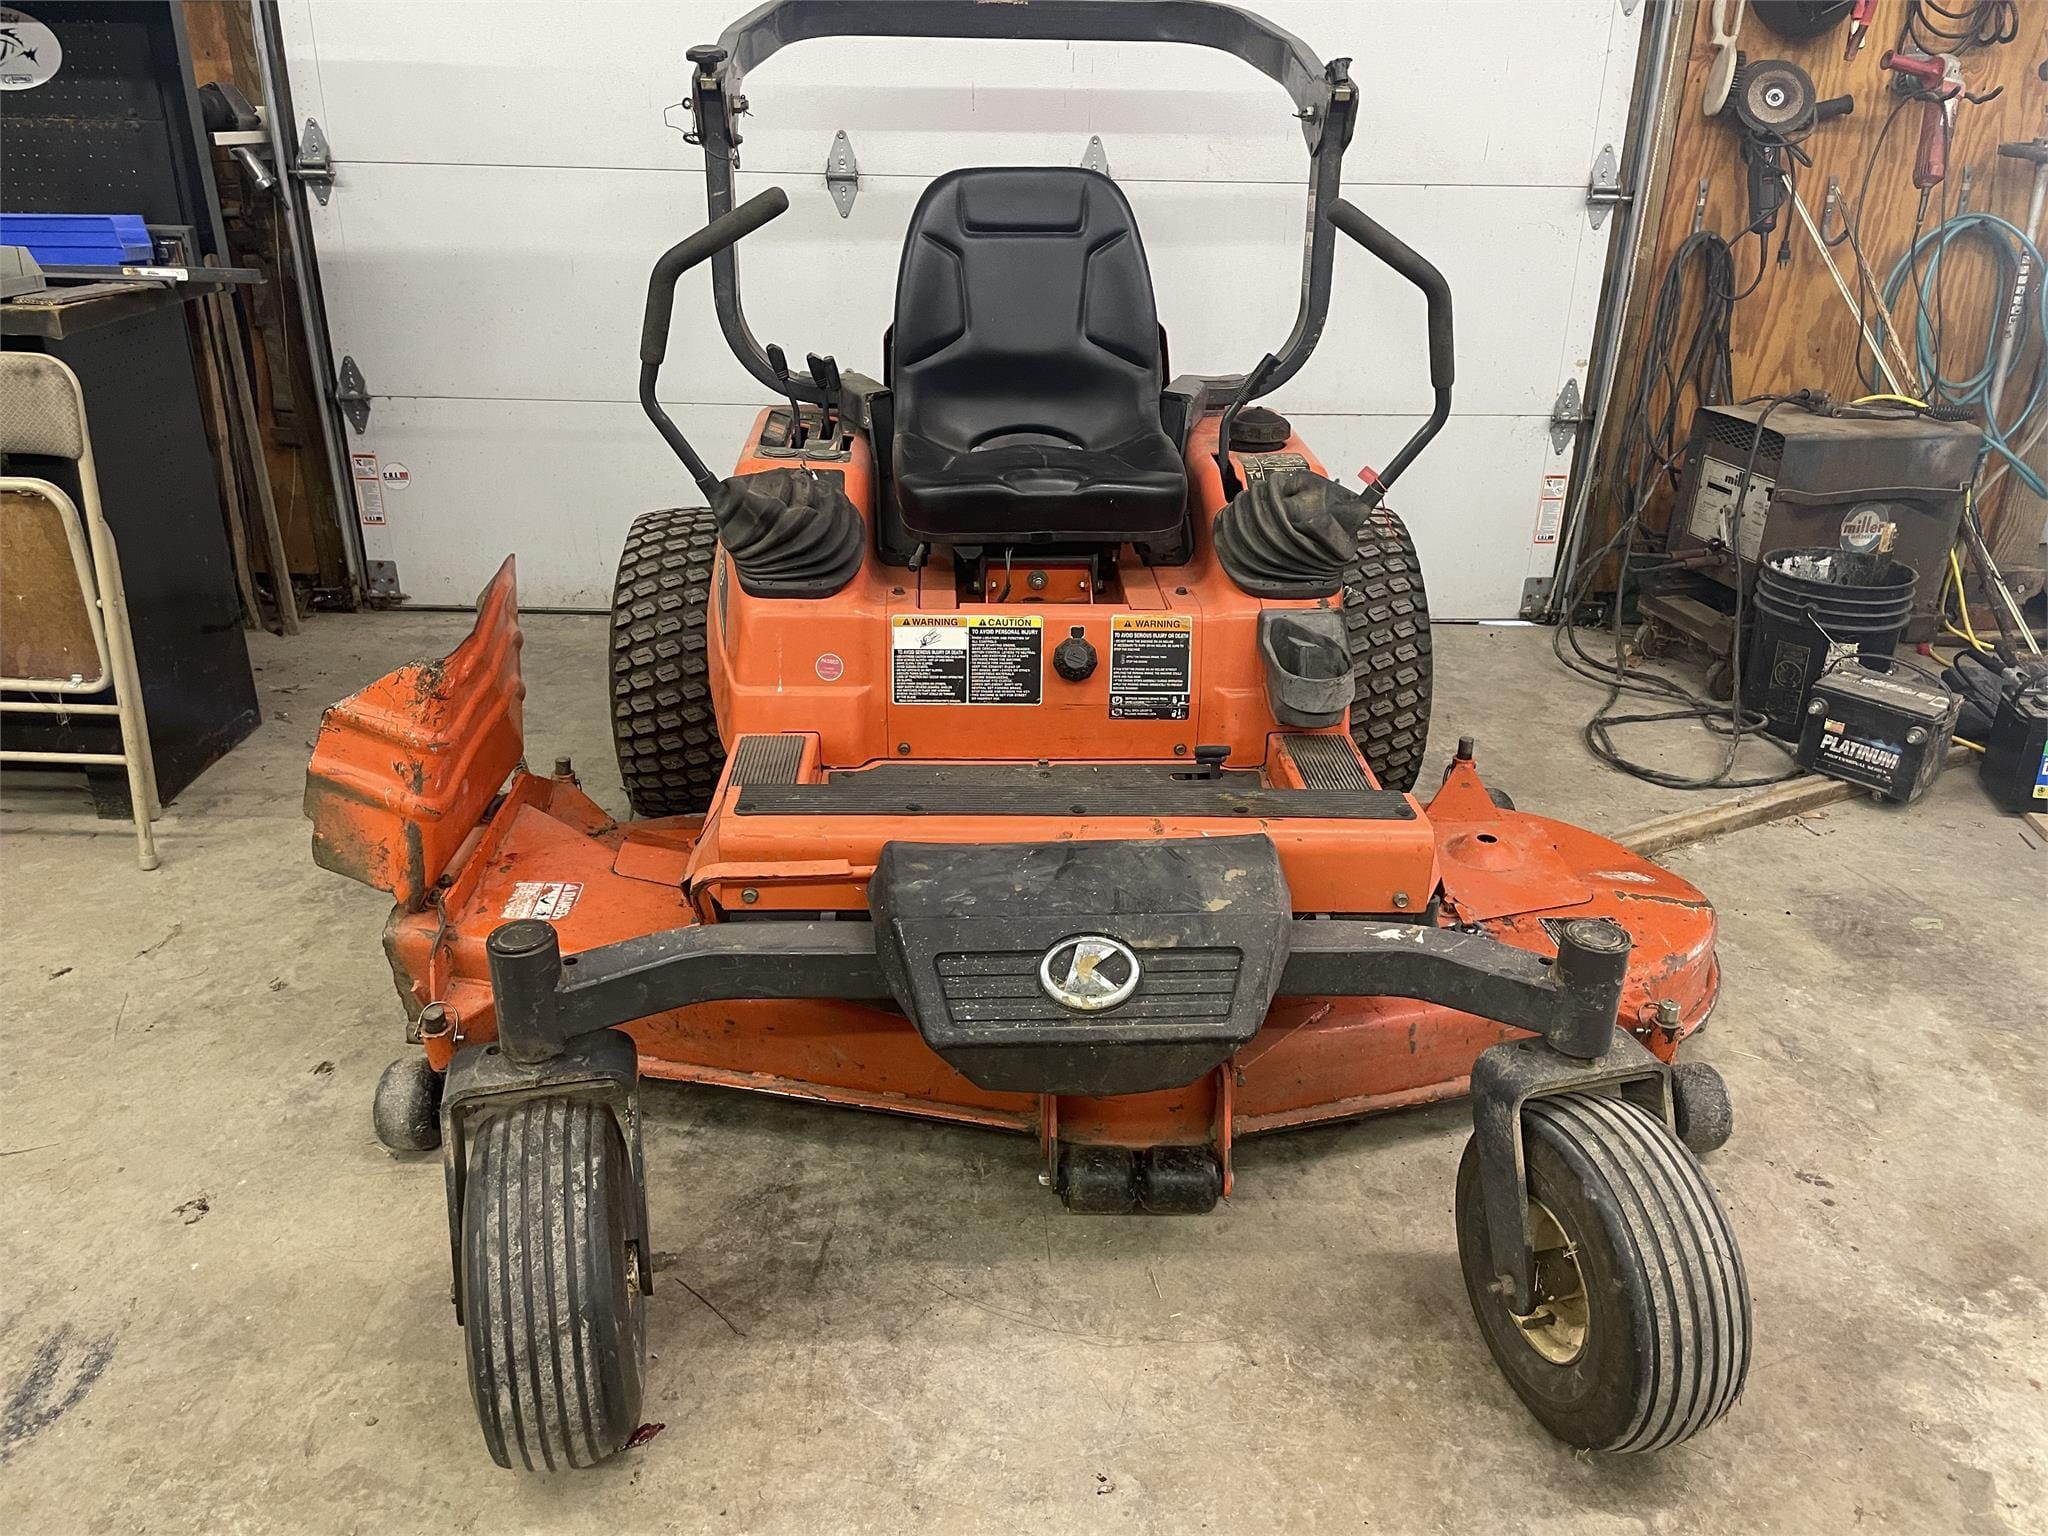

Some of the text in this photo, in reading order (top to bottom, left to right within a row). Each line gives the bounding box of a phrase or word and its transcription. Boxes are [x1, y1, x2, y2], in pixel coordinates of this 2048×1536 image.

[1725, 472, 1756, 492] milr
[1843, 516, 1885, 533] miller
[912, 618, 958, 626] WARNING
[988, 618, 1031, 626] CAUTION
[1136, 620, 1180, 628] WARNING
[1820, 734, 1900, 770] PLATINUM
